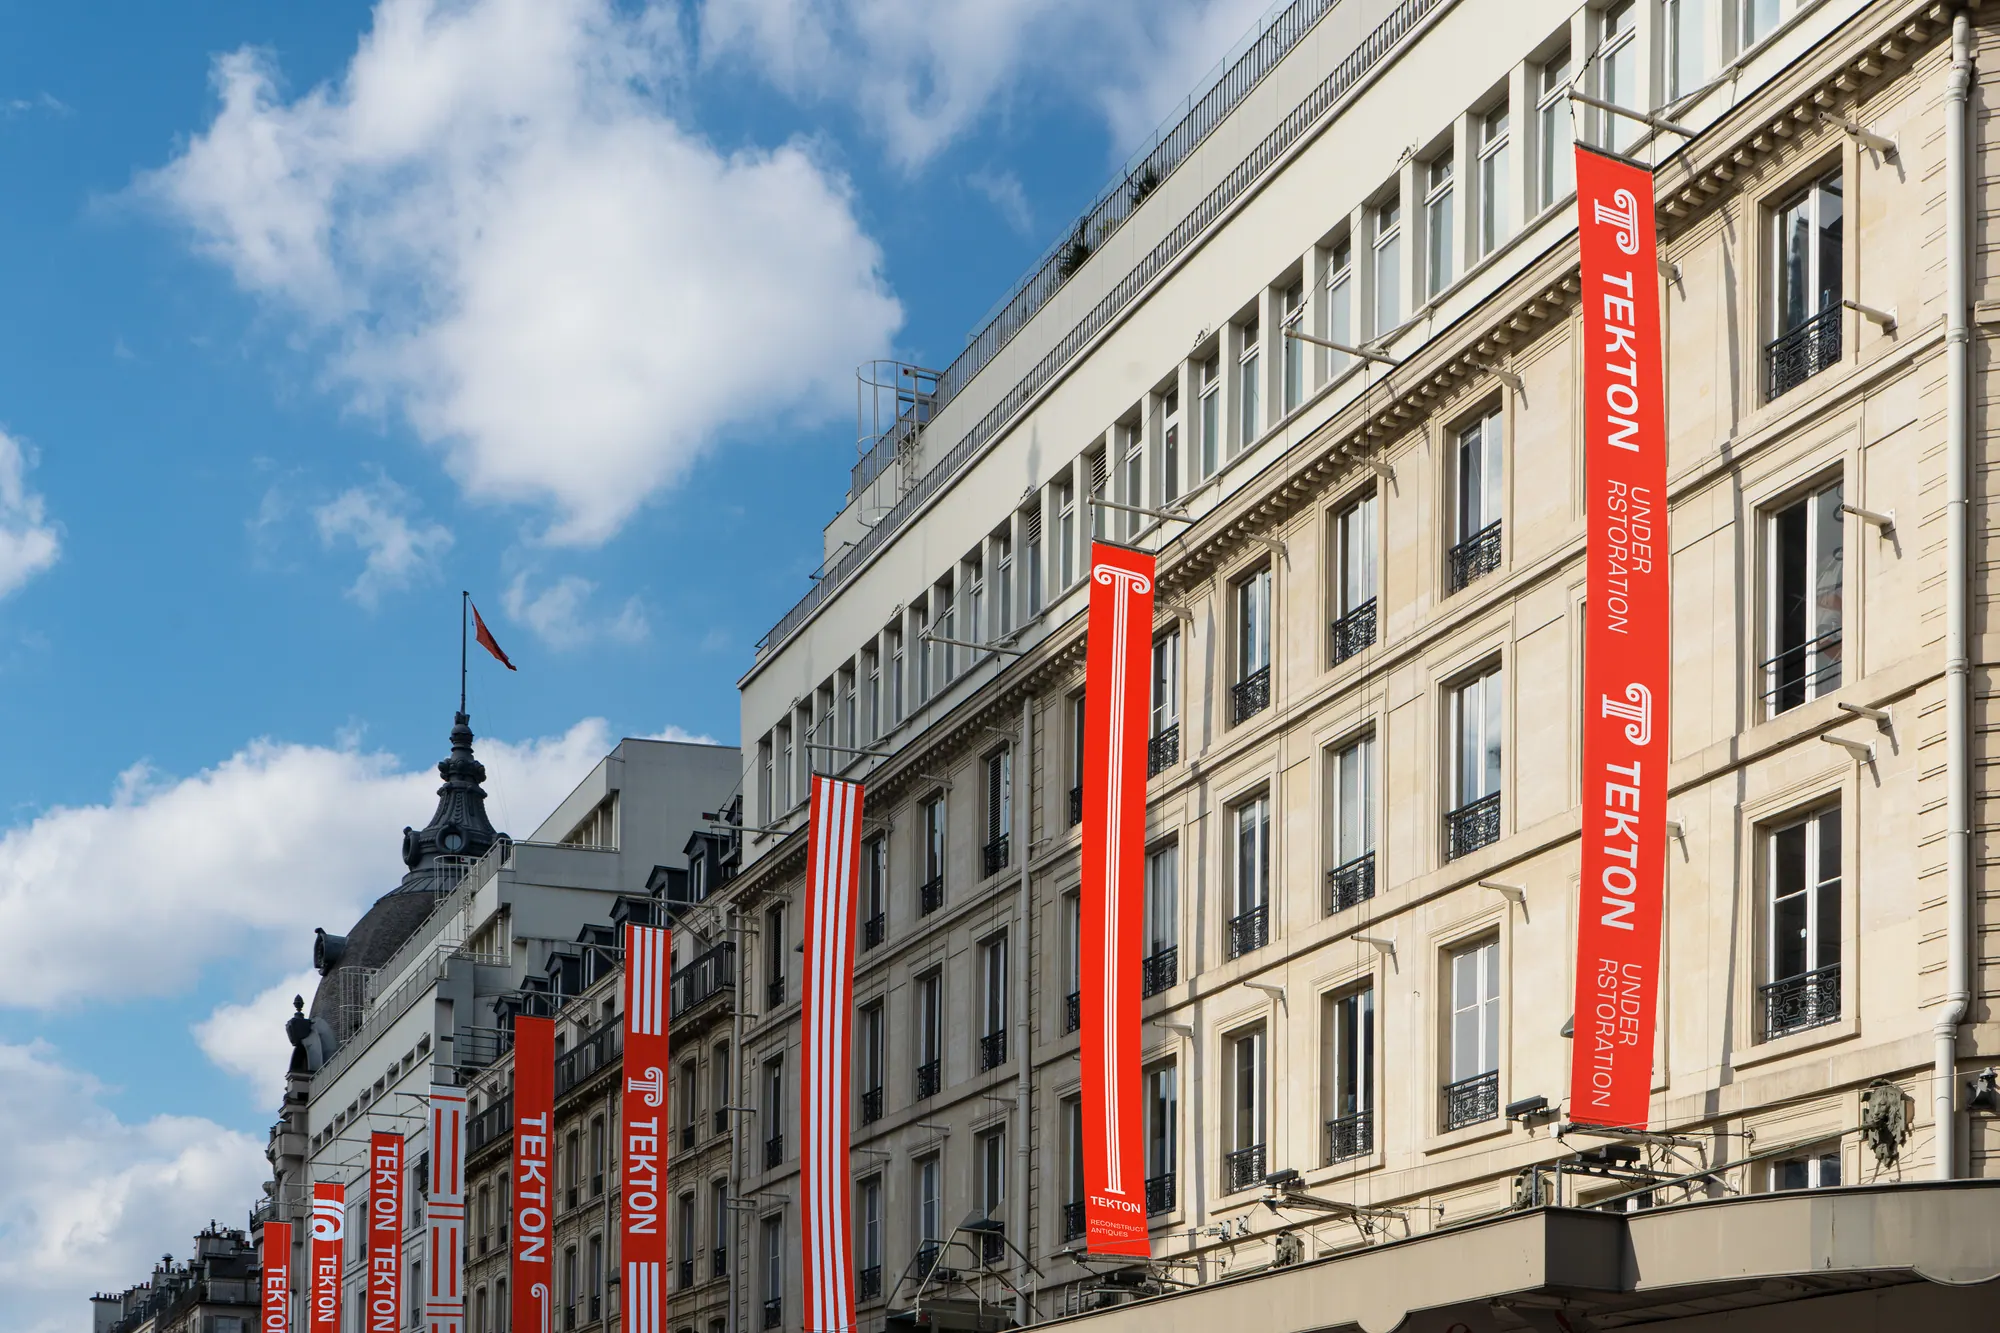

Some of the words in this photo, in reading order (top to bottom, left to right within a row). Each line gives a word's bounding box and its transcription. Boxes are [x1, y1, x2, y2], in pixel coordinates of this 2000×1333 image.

[1603, 271, 1639, 452] TEKTON
[1607, 479, 1628, 634] RSTORATION
[1631, 487, 1651, 574] UNDER
[1601, 761, 1641, 930] TEKTON
[1591, 958, 1617, 1107] RSTORATION
[1618, 964, 1642, 1046] UNDER
[375, 1143, 398, 1231] TEKTON
[519, 1112, 547, 1263] TEKTON
[629, 1117, 657, 1234] TEKTON
[1090, 1196, 1140, 1213] TEKTON
[1090, 1219, 1144, 1232] RECONSTRUCT
[1091, 1227, 1128, 1238] ANTIQUES
[318, 1254, 337, 1322] TEKTON
[372, 1245, 396, 1331] TEKTON
